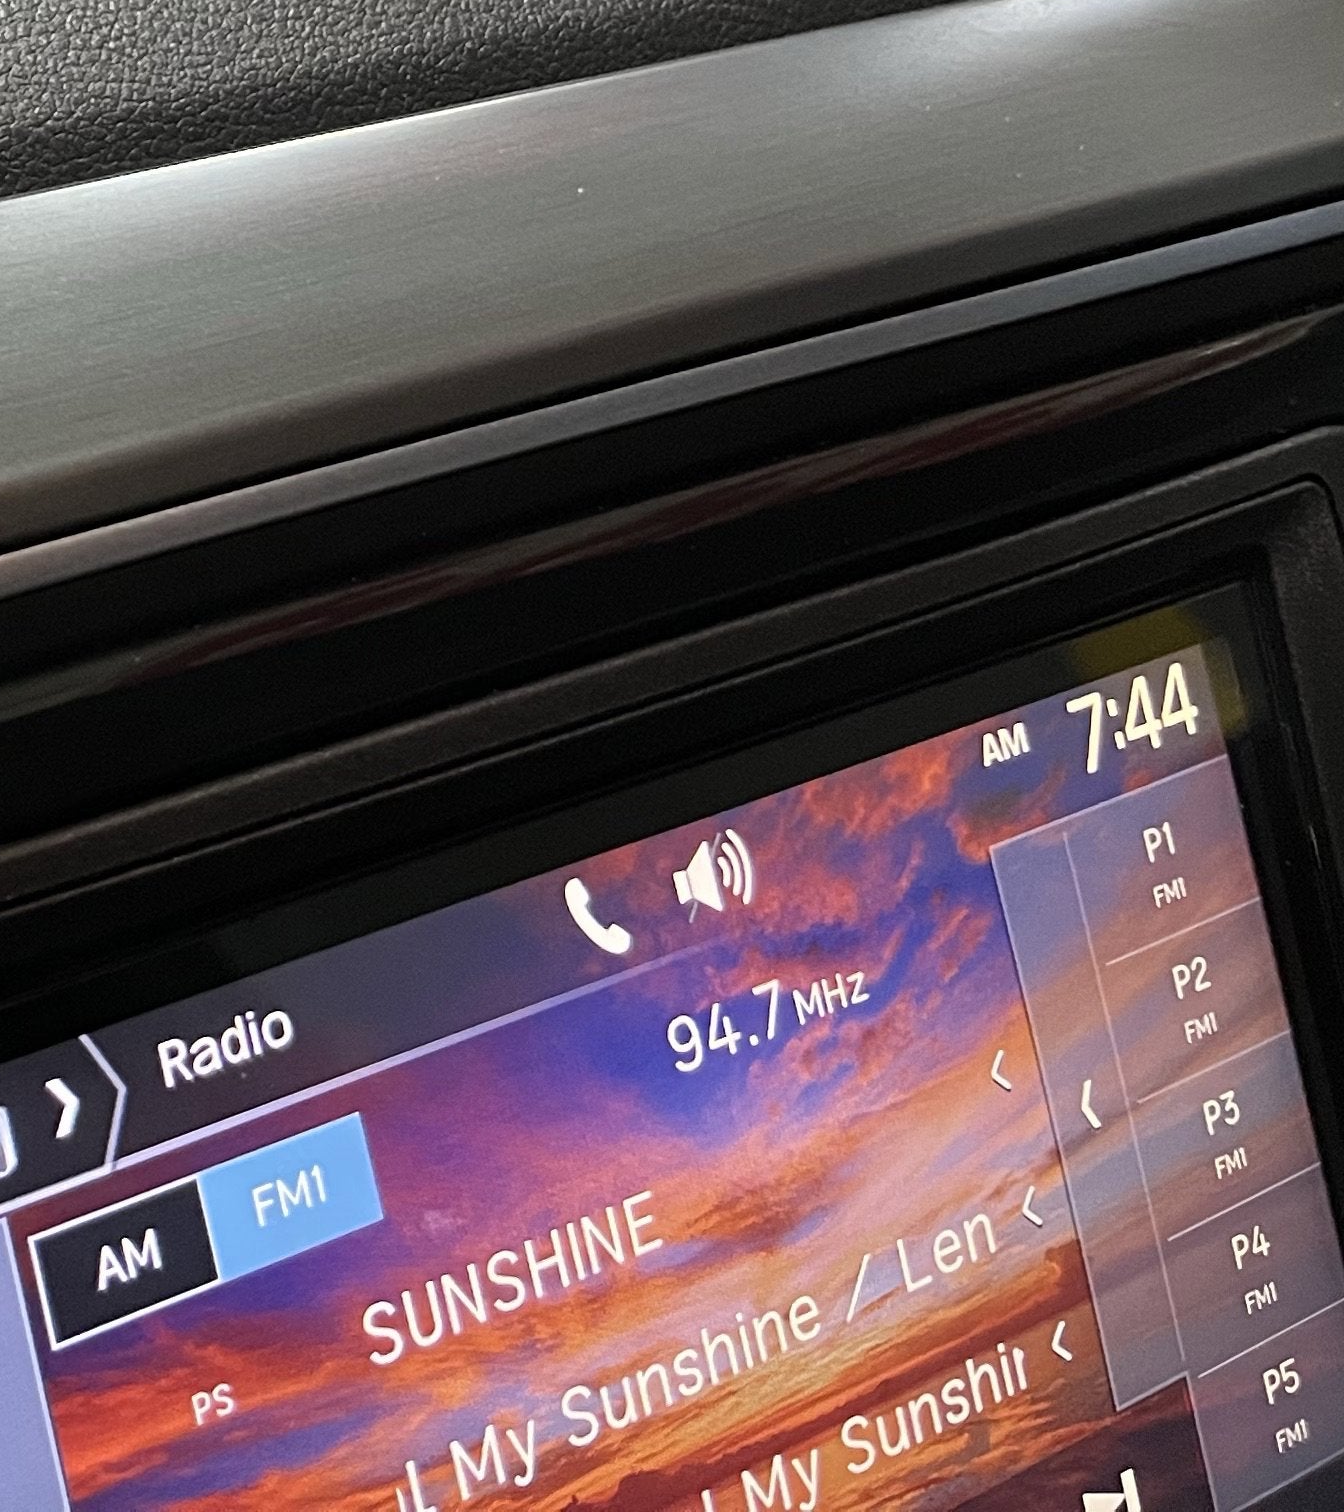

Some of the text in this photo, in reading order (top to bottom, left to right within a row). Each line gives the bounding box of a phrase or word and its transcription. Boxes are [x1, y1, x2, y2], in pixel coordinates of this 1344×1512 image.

[982, 662, 1200, 775] AM 7:44
[1143, 825, 1176, 863] P1
[1152, 876, 1187, 909] FM1
[1171, 963, 1212, 1000] P2
[667, 971, 870, 1073] 94.7 MHz
[1183, 1011, 1218, 1044] FM1
[157, 1010, 294, 1088] Radio
[1202, 1090, 1241, 1136] P3
[1214, 1147, 1248, 1180] FM1
[252, 1165, 326, 1226] FM1
[97, 1228, 162, 1291] AM
[1231, 1225, 1271, 1270] P4
[362, 1190, 664, 1365] SUNSHINE
[1244, 1281, 1278, 1315] FM1
[449, 1418, 535, 1501] My
[560, 1288, 822, 1447] Sunshine
[894, 1208, 999, 1294] Len
[1262, 1357, 1300, 1405] P5
[191, 1383, 235, 1426] PS
[1275, 1418, 1308, 1453] FM1
[741, 1448, 818, 1512] My
